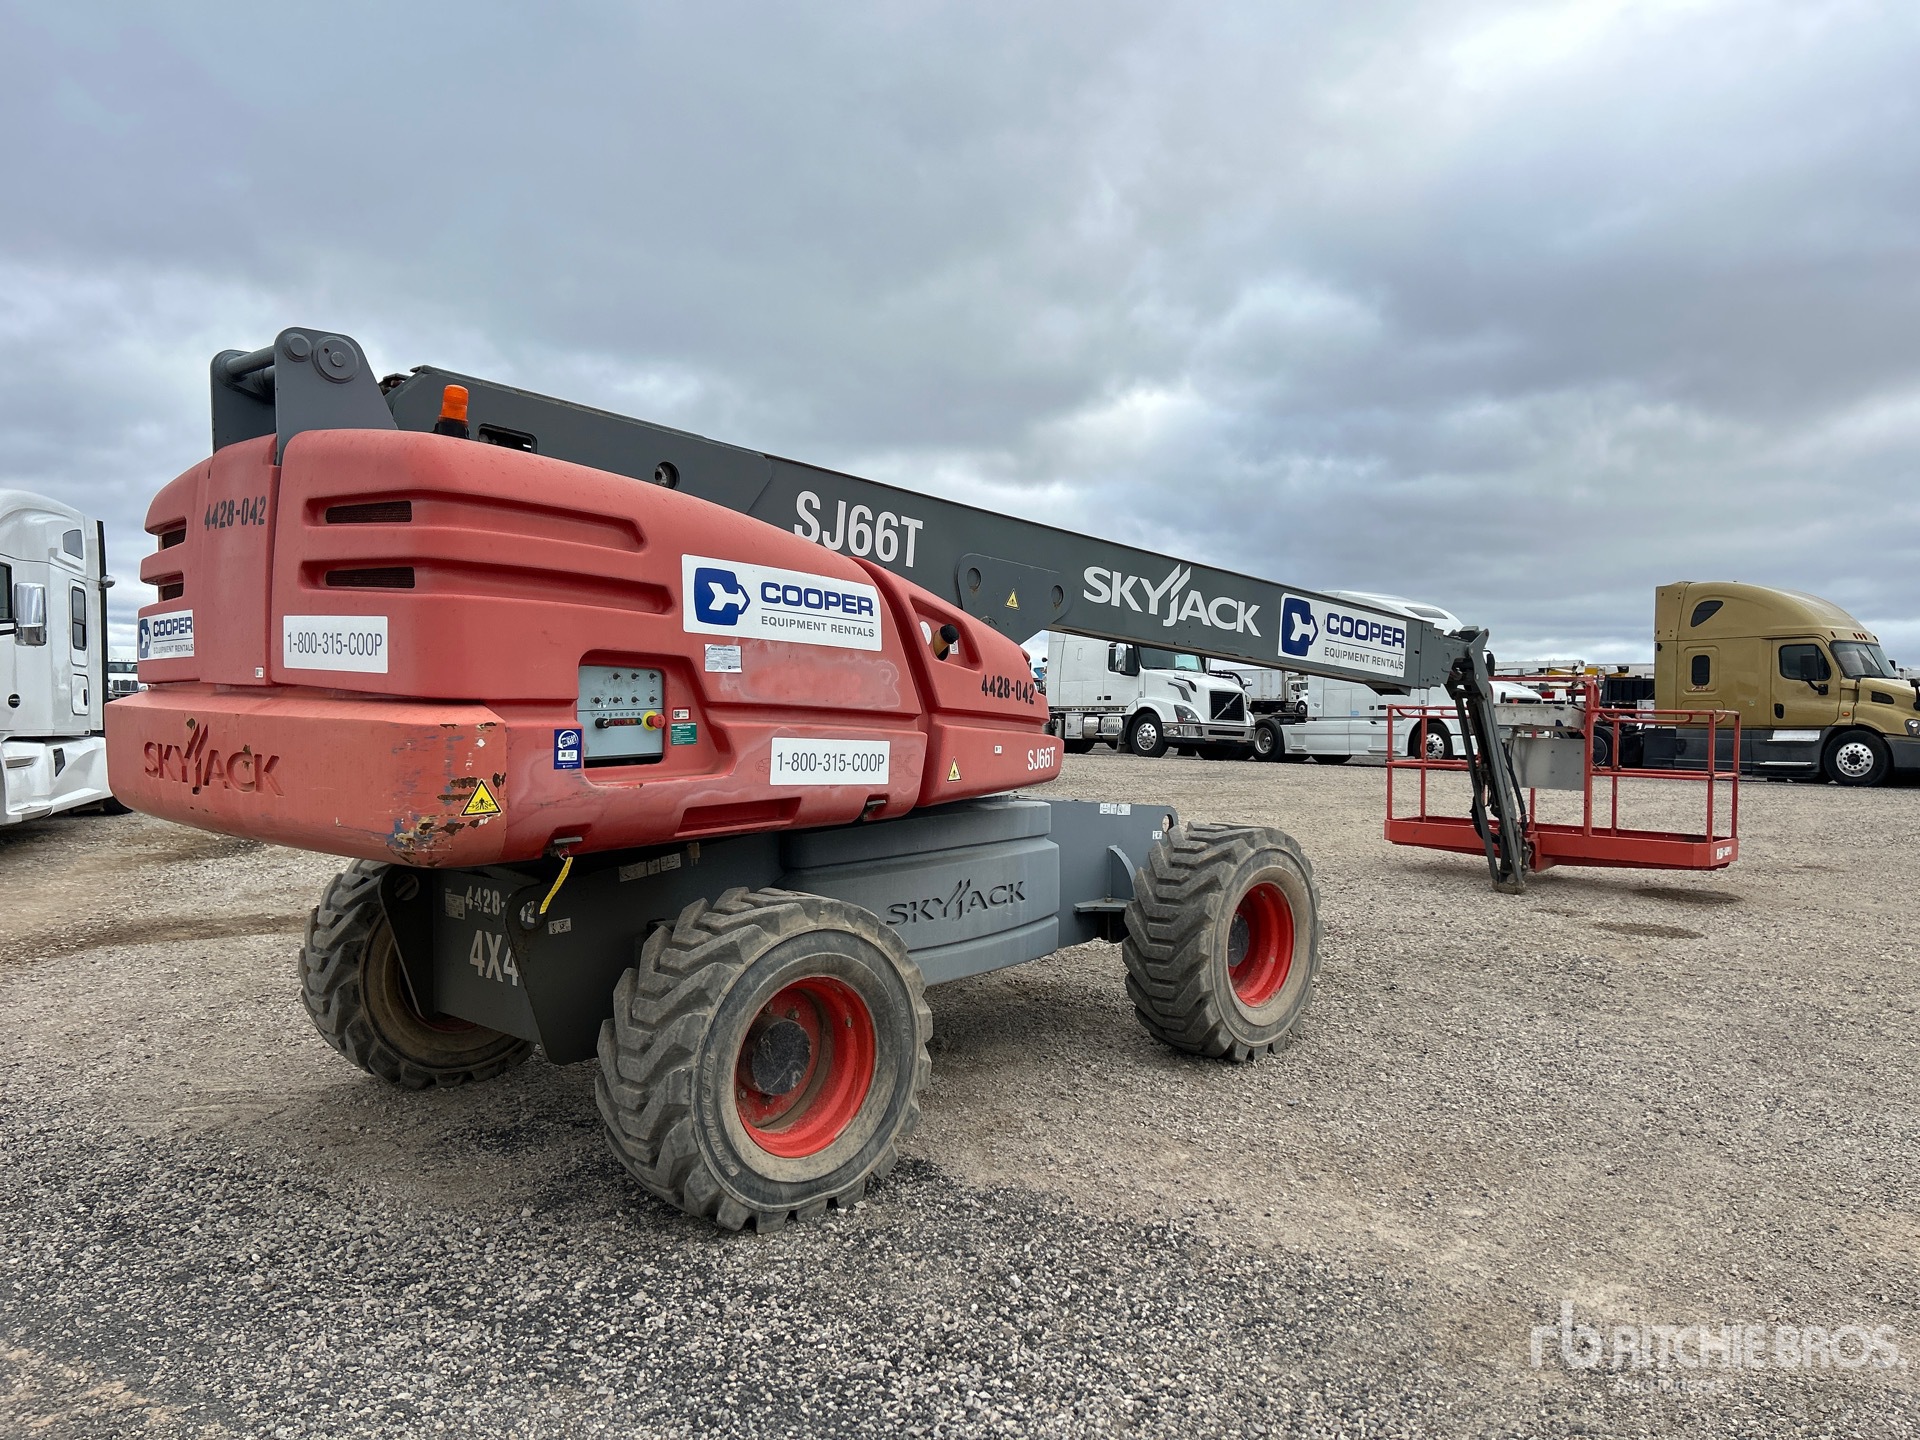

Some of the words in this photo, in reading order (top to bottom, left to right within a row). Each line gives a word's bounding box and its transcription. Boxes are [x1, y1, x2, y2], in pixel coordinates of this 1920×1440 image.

[204, 496, 267, 532] 4428-042
[793, 489, 923, 568] SJ66T
[760, 581, 875, 617] COOPER
[1082, 563, 1262, 638] SKYJACK
[153, 616, 193, 637] COOPER
[761, 615, 827, 632] EQUIPMENT
[830, 624, 875, 638] RENTALS
[1326, 612, 1405, 649] COOPER
[174, 643, 194, 653] RENTALS
[287, 631, 384, 657] 1-800-315-COOP
[1324, 646, 1370, 662] EQUIPMENT
[1371, 655, 1404, 670] RENTALS
[981, 674, 1035, 705] 4428-042
[143, 722, 285, 797] SKYJACK
[777, 752, 885, 772] 1-800-315-COOP
[1027, 746, 1056, 771] SJ66T
[886, 878, 1026, 926] SKYJACK
[469, 929, 519, 987] 4X4
